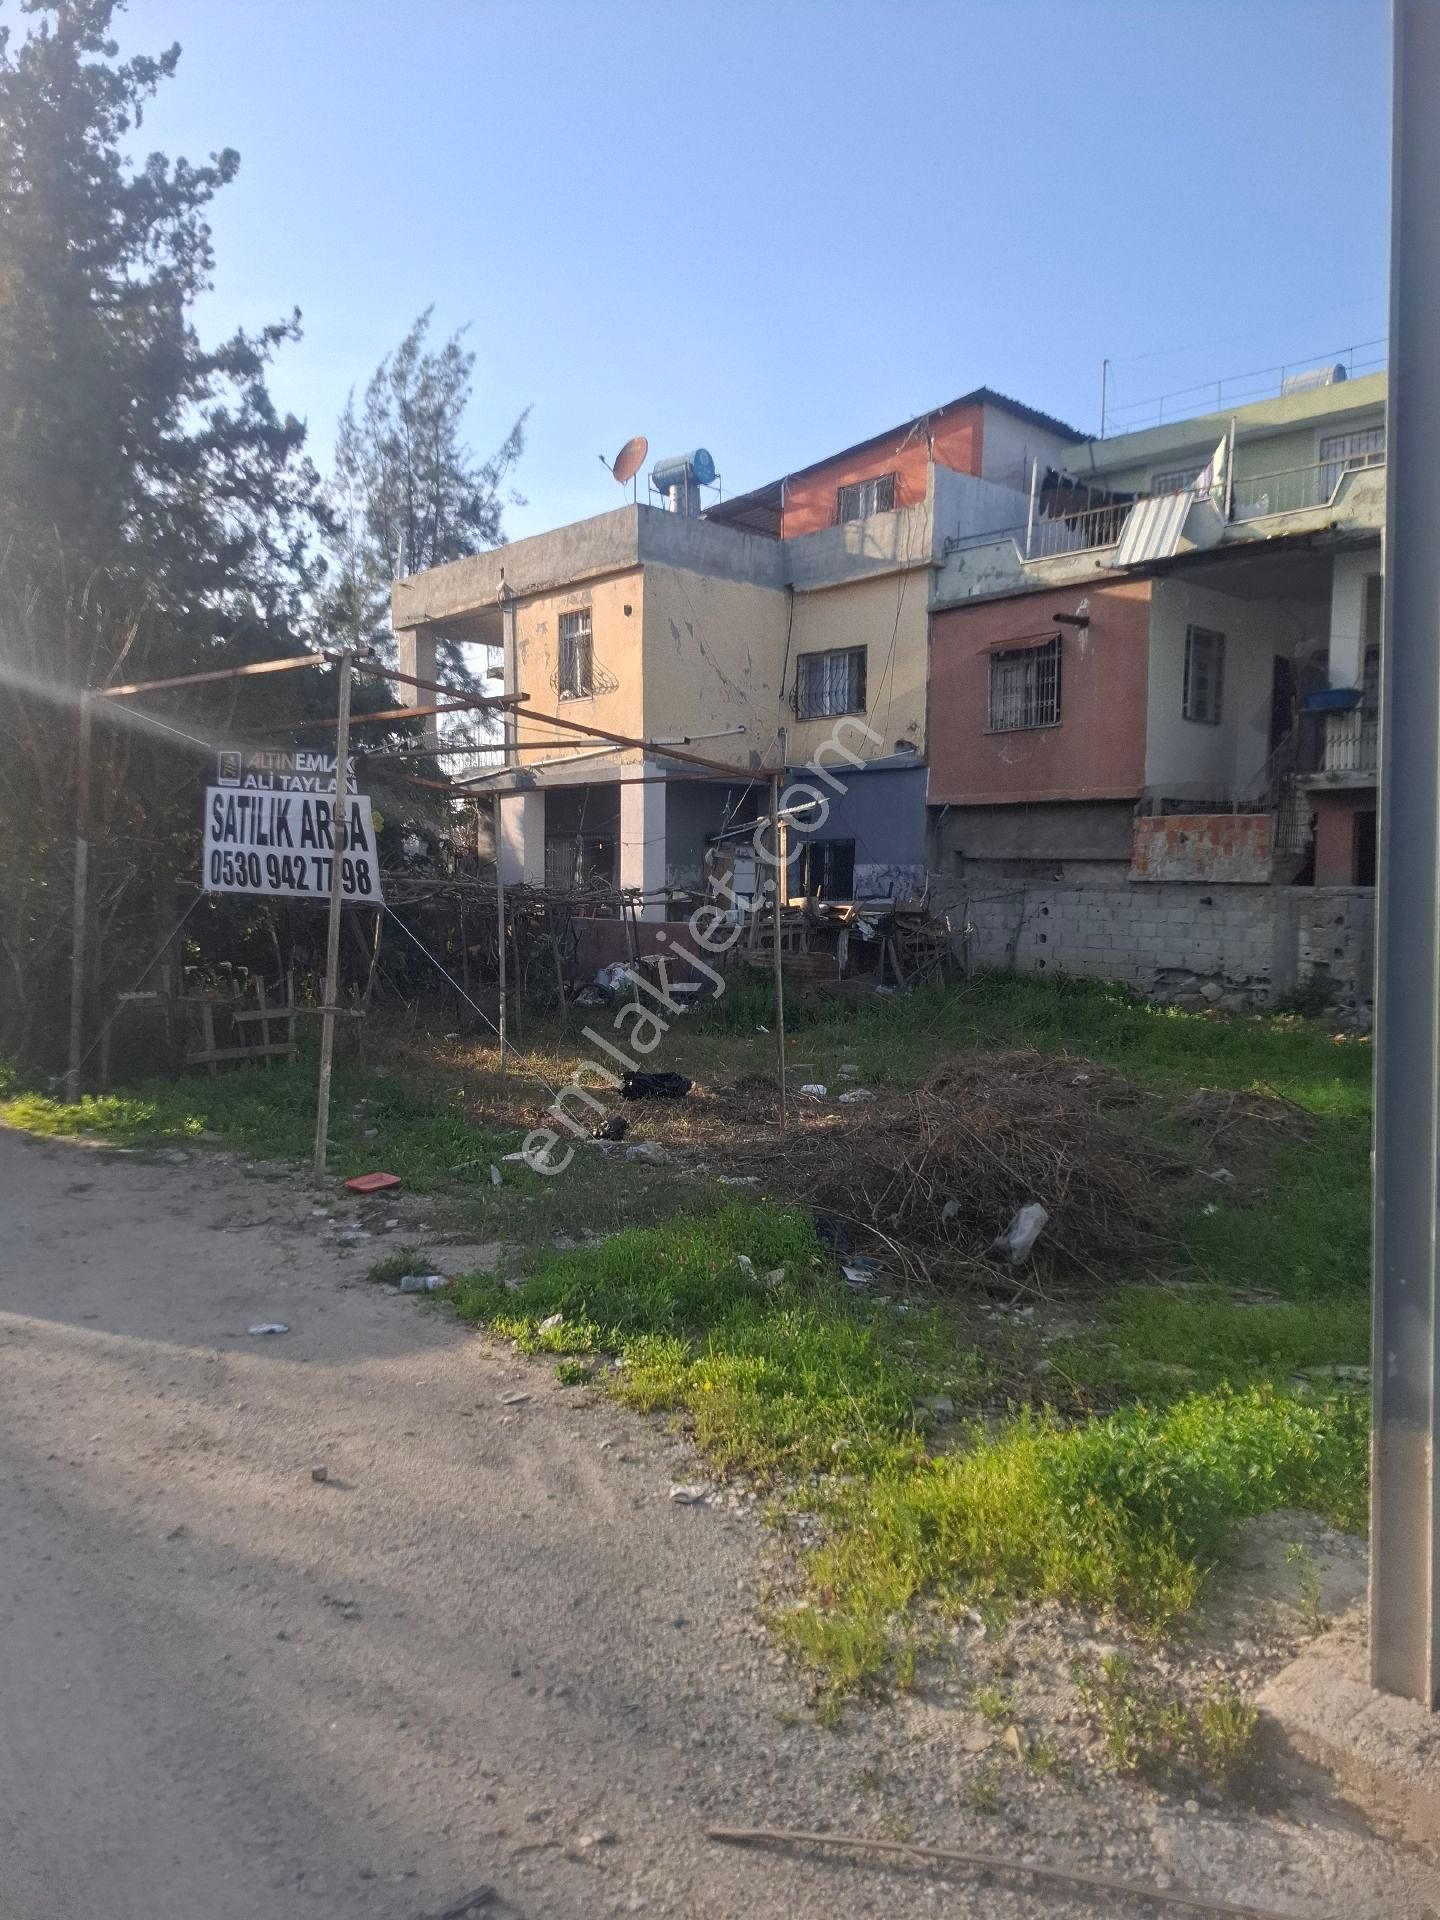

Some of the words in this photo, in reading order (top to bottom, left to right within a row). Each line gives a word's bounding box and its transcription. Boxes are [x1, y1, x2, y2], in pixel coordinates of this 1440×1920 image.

[244, 771, 274, 790] ALİ
[211, 793, 294, 848] SATILIK
[211, 849, 262, 888] 0530
[266, 854, 309, 890] 942
[342, 857, 372, 895] 98
